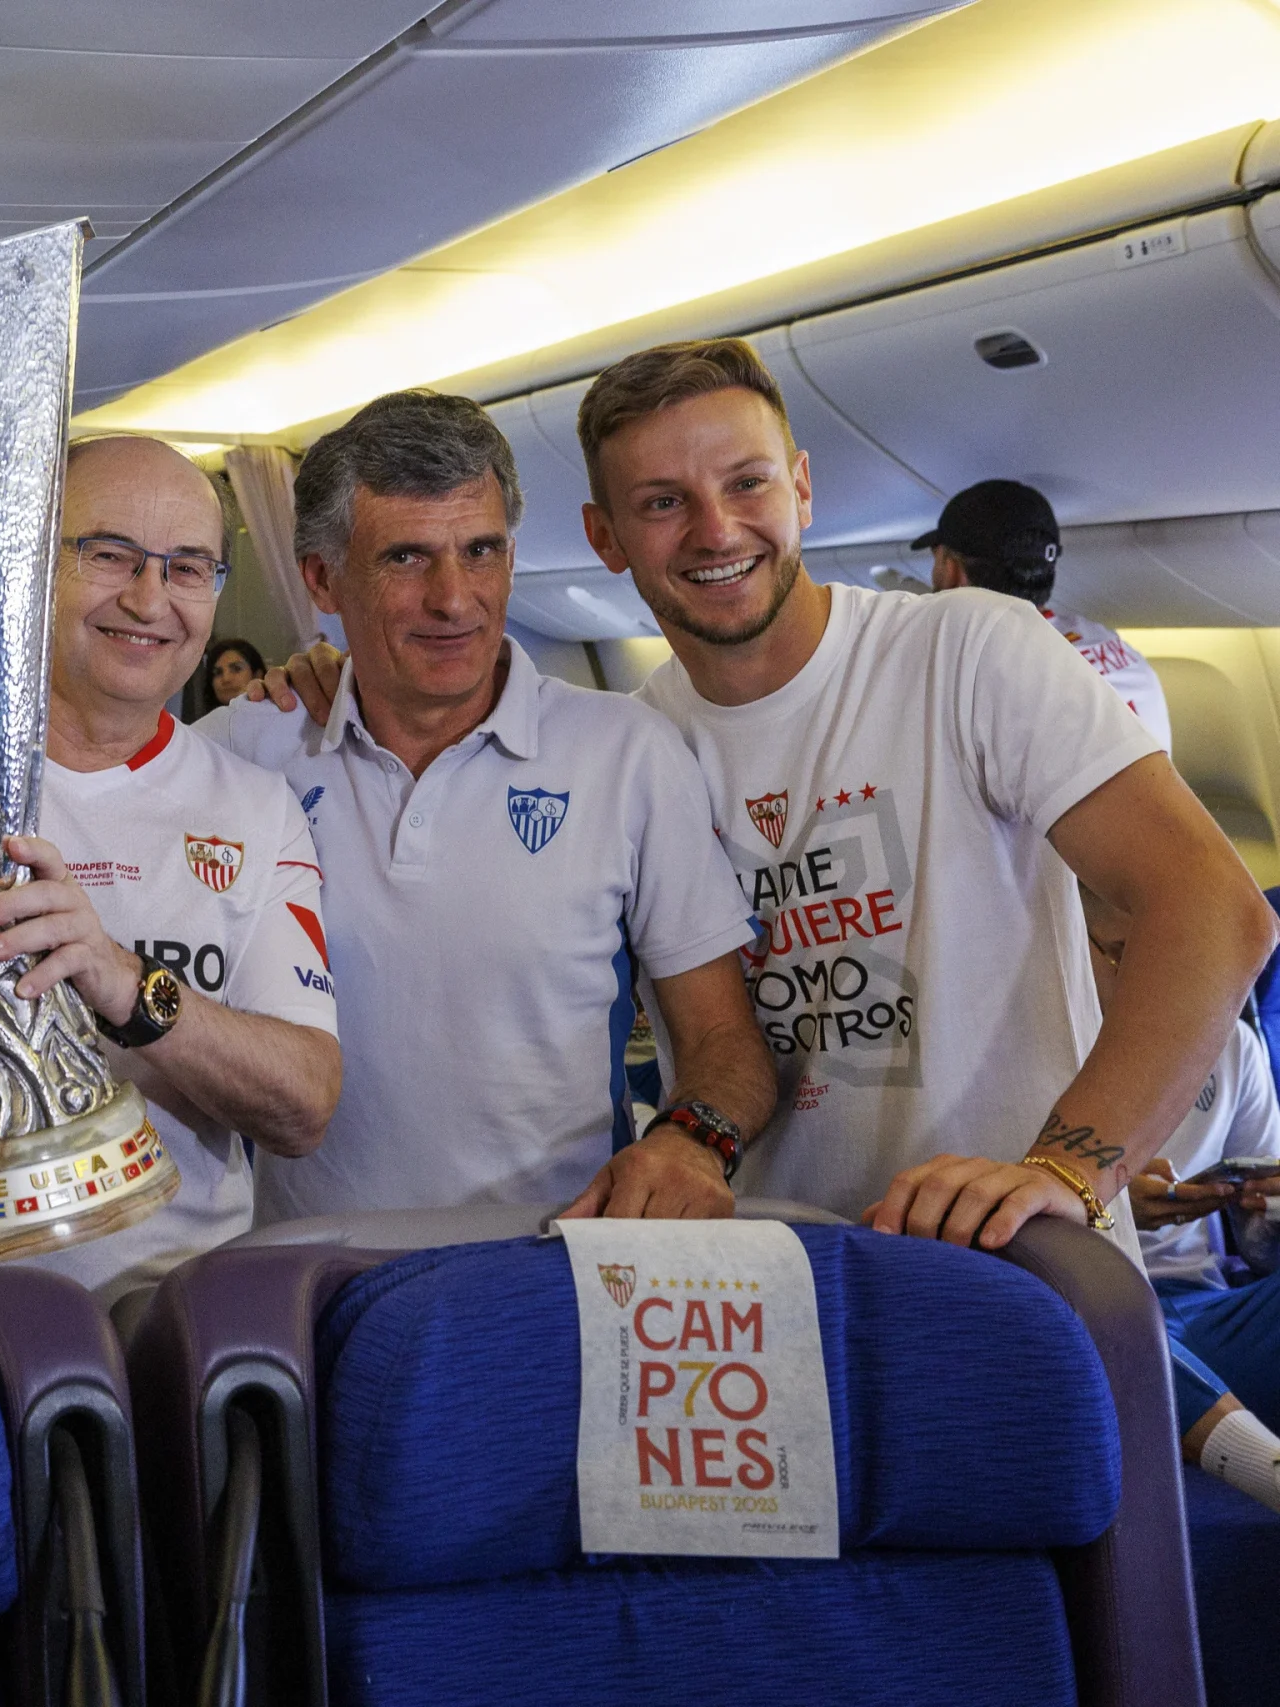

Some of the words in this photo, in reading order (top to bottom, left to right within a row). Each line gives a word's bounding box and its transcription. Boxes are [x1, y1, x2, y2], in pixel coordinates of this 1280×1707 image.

[115, 863, 140, 874] 2023
[744, 956, 868, 1012] OMO
[29, 1153, 109, 1190] UEFA
[633, 1297, 764, 1353] CAM
[635, 1426, 776, 1491] NES
[639, 1493, 727, 1512] BUDAPEST
[732, 1496, 779, 1514] 2023
